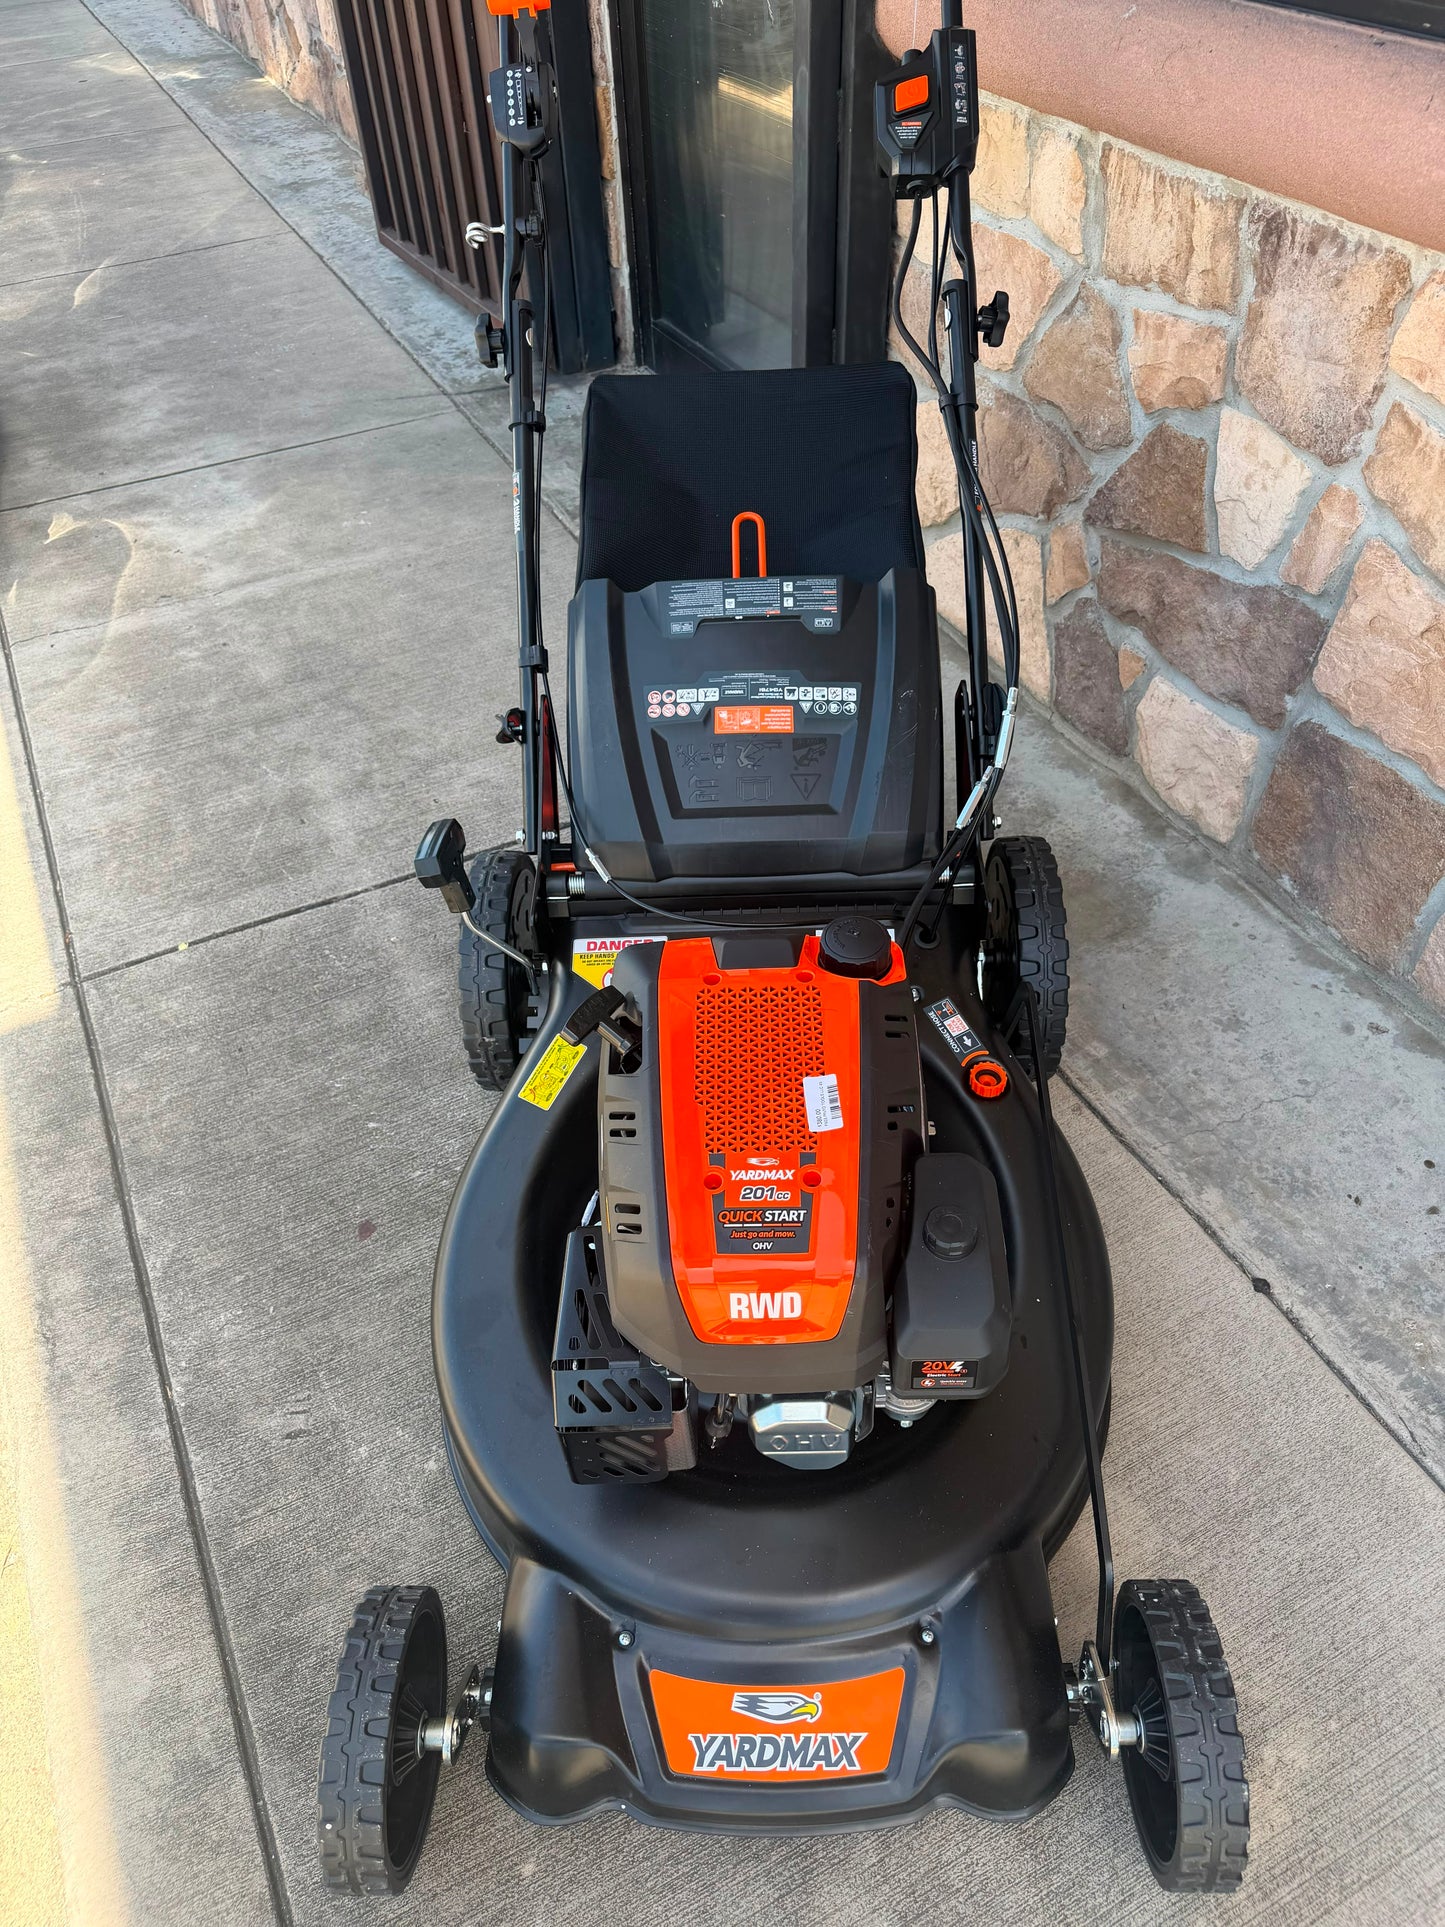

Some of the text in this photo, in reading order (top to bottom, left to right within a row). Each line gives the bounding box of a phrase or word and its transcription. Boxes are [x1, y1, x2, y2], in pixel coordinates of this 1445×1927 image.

[586, 939, 654, 951] DANG
[927, 1011, 960, 1053] CONNECT HOSE
[729, 1169, 795, 1181] YARDMAX
[718, 1209, 807, 1223] QUICK START
[730, 1230, 795, 1239] Just go and mow.
[752, 1241, 773, 1250] OHV
[730, 1292, 802, 1319] RWD
[688, 1732, 868, 1771] YARDMAX
